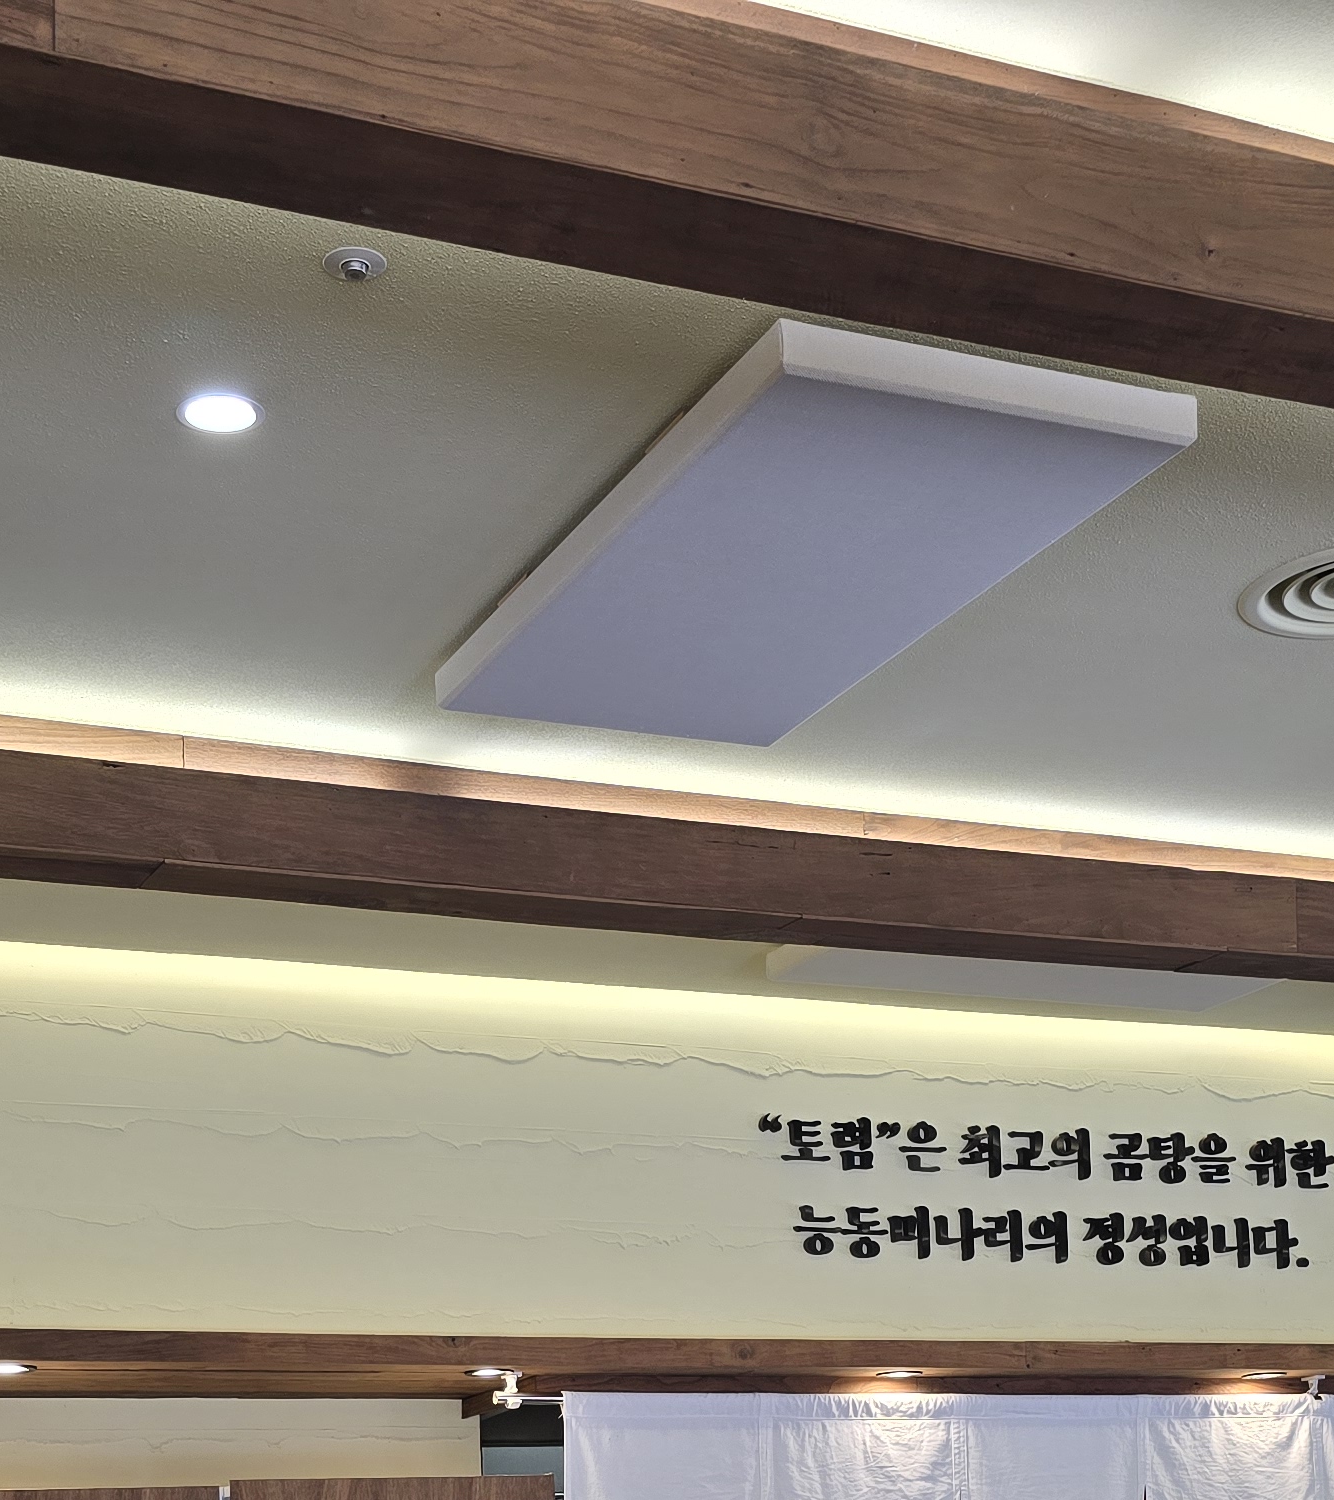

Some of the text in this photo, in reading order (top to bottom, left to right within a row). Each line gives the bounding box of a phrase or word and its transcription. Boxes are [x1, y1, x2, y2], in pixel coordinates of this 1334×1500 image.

[957, 1124, 1092, 1180] 최고의
[1102, 1130, 1237, 1185] 곰탕을
[791, 1204, 1310, 1270] 능동미나리의 정성입니다.
